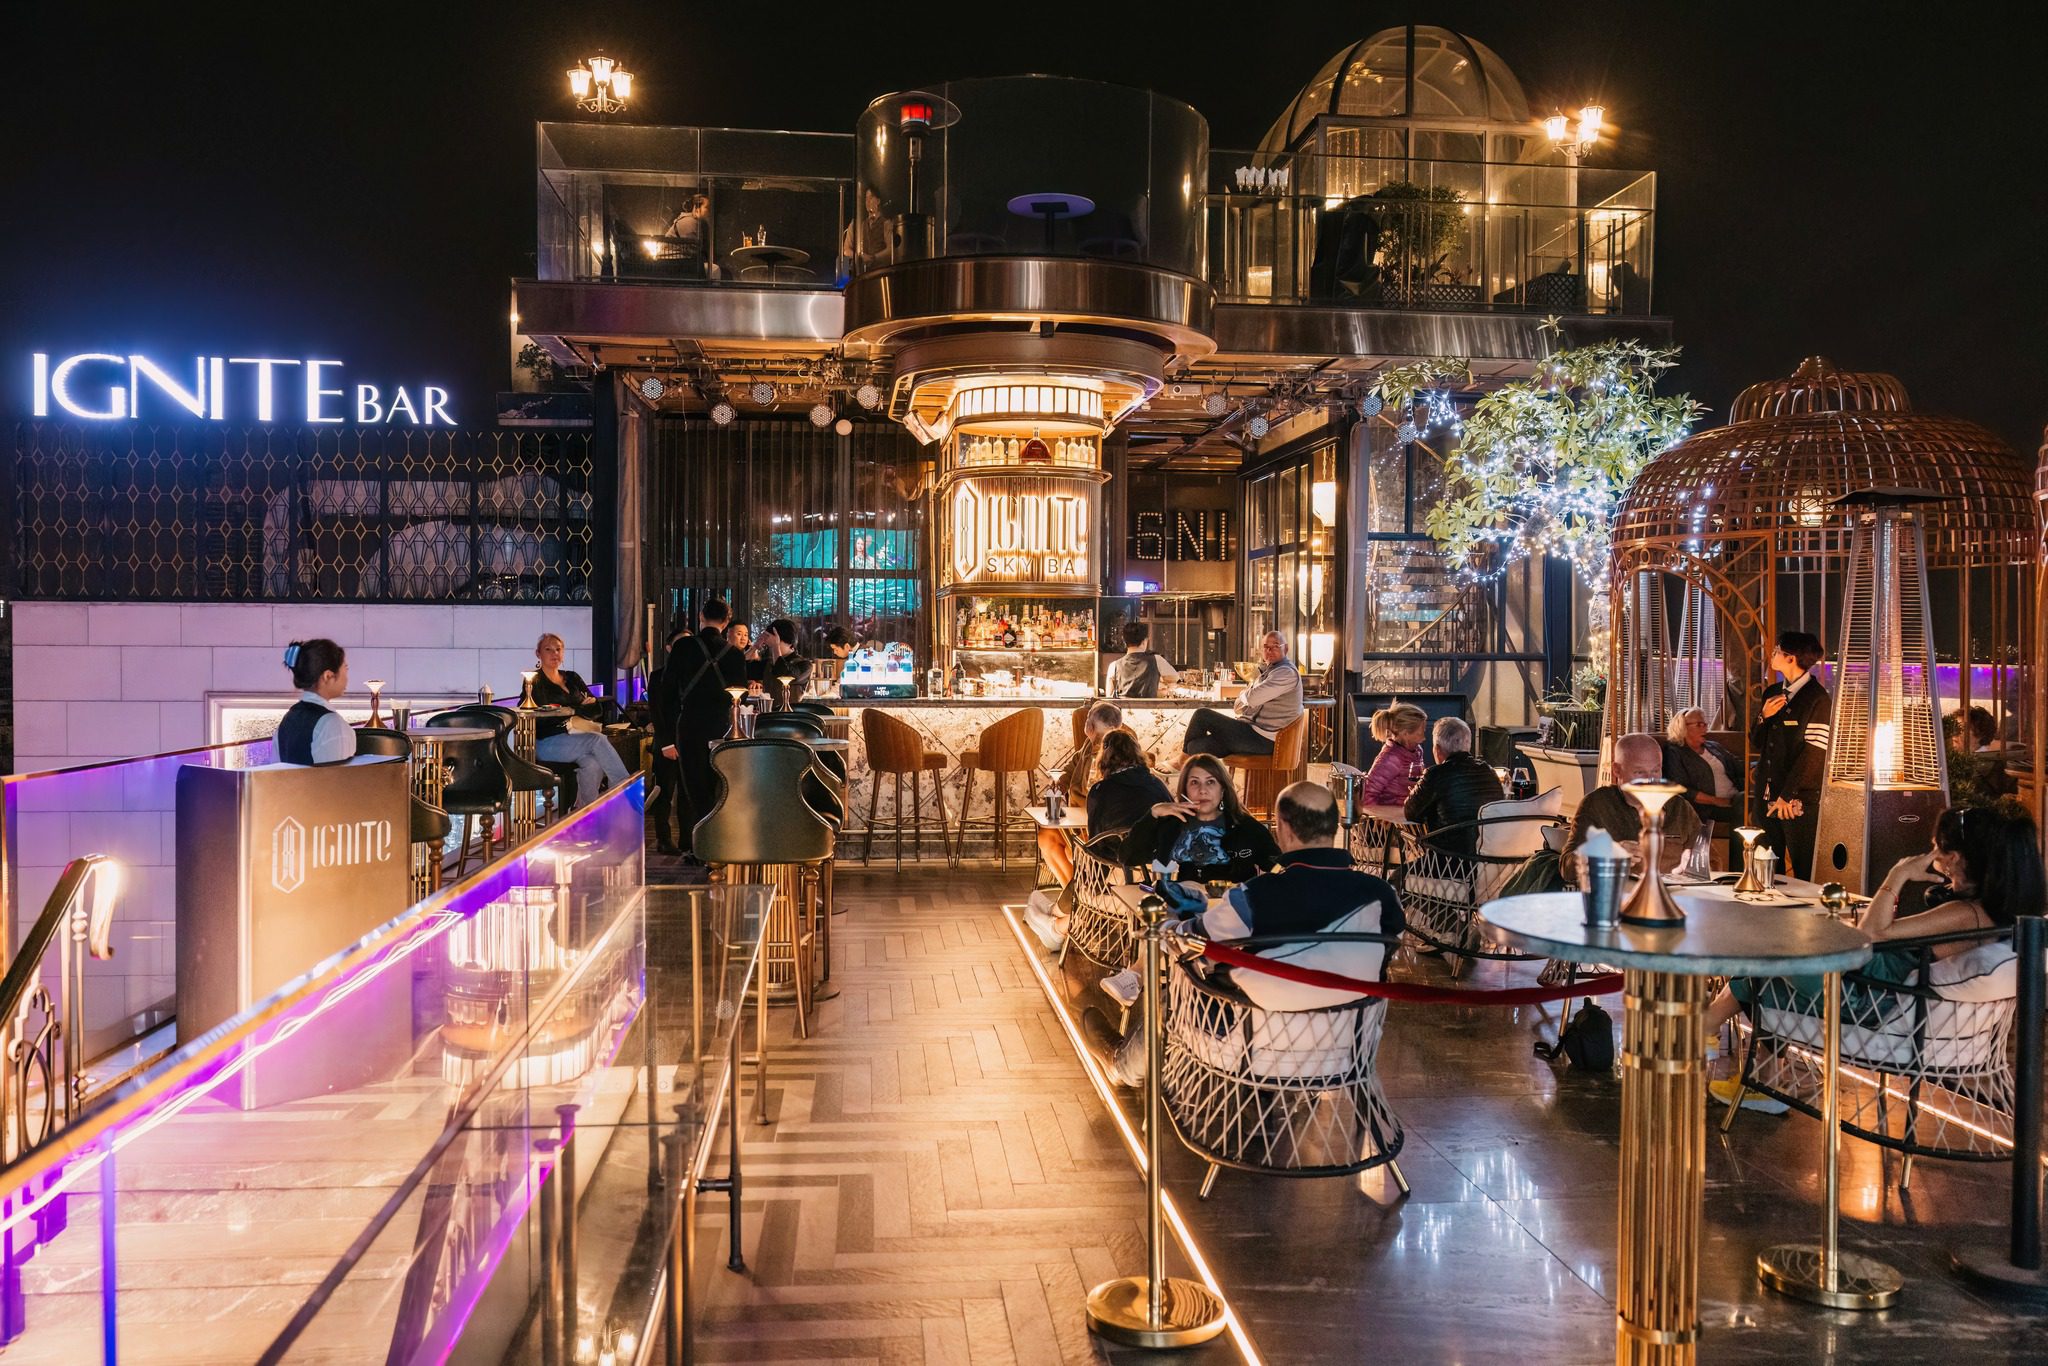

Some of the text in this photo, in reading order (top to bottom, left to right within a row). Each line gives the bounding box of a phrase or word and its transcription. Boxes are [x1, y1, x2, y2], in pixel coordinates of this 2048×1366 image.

[33, 353, 459, 425] IGNITE BAR
[987, 557, 1088, 575] SKY BA
